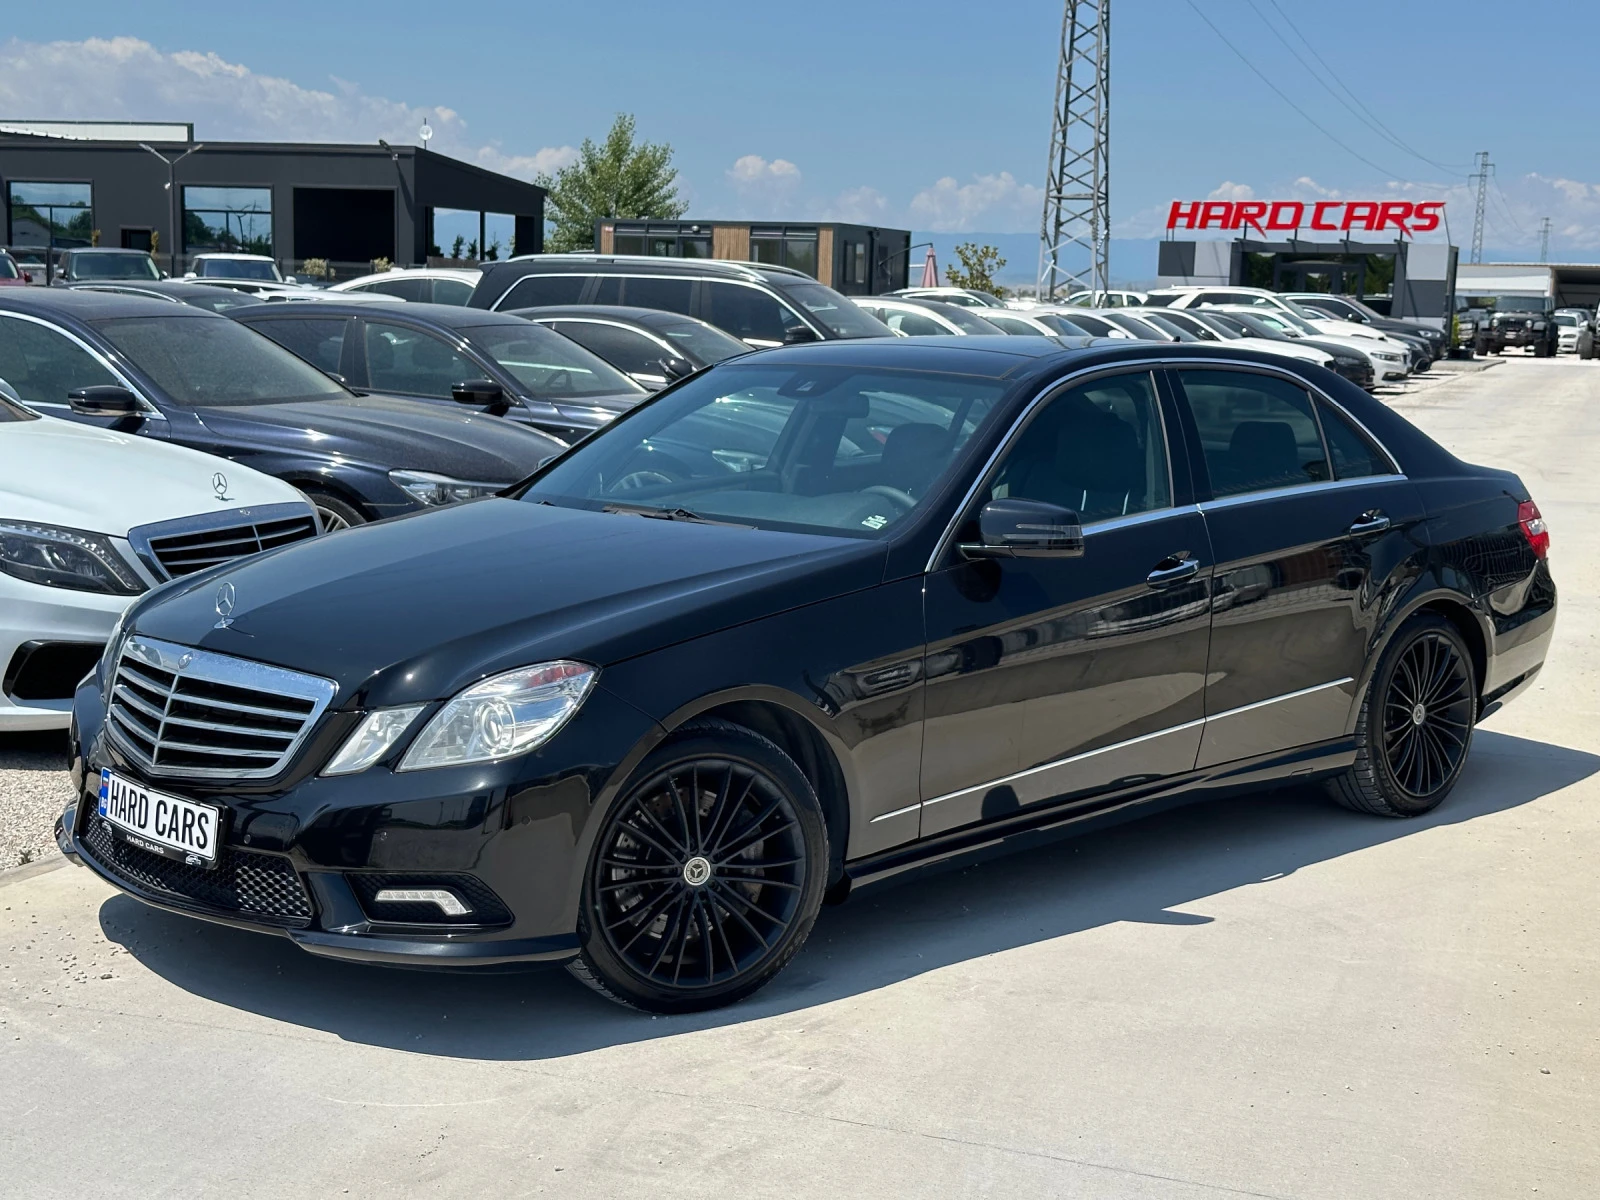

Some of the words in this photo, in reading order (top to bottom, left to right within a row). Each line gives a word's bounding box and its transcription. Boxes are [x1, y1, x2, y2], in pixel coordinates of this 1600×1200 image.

[1166, 201, 1304, 239] HARD
[1311, 201, 1446, 239] CARS
[109, 779, 149, 830] HARD
[155, 799, 209, 850] CARS
[126, 834, 145, 847] HARD
[145, 843, 164, 854] CARS
